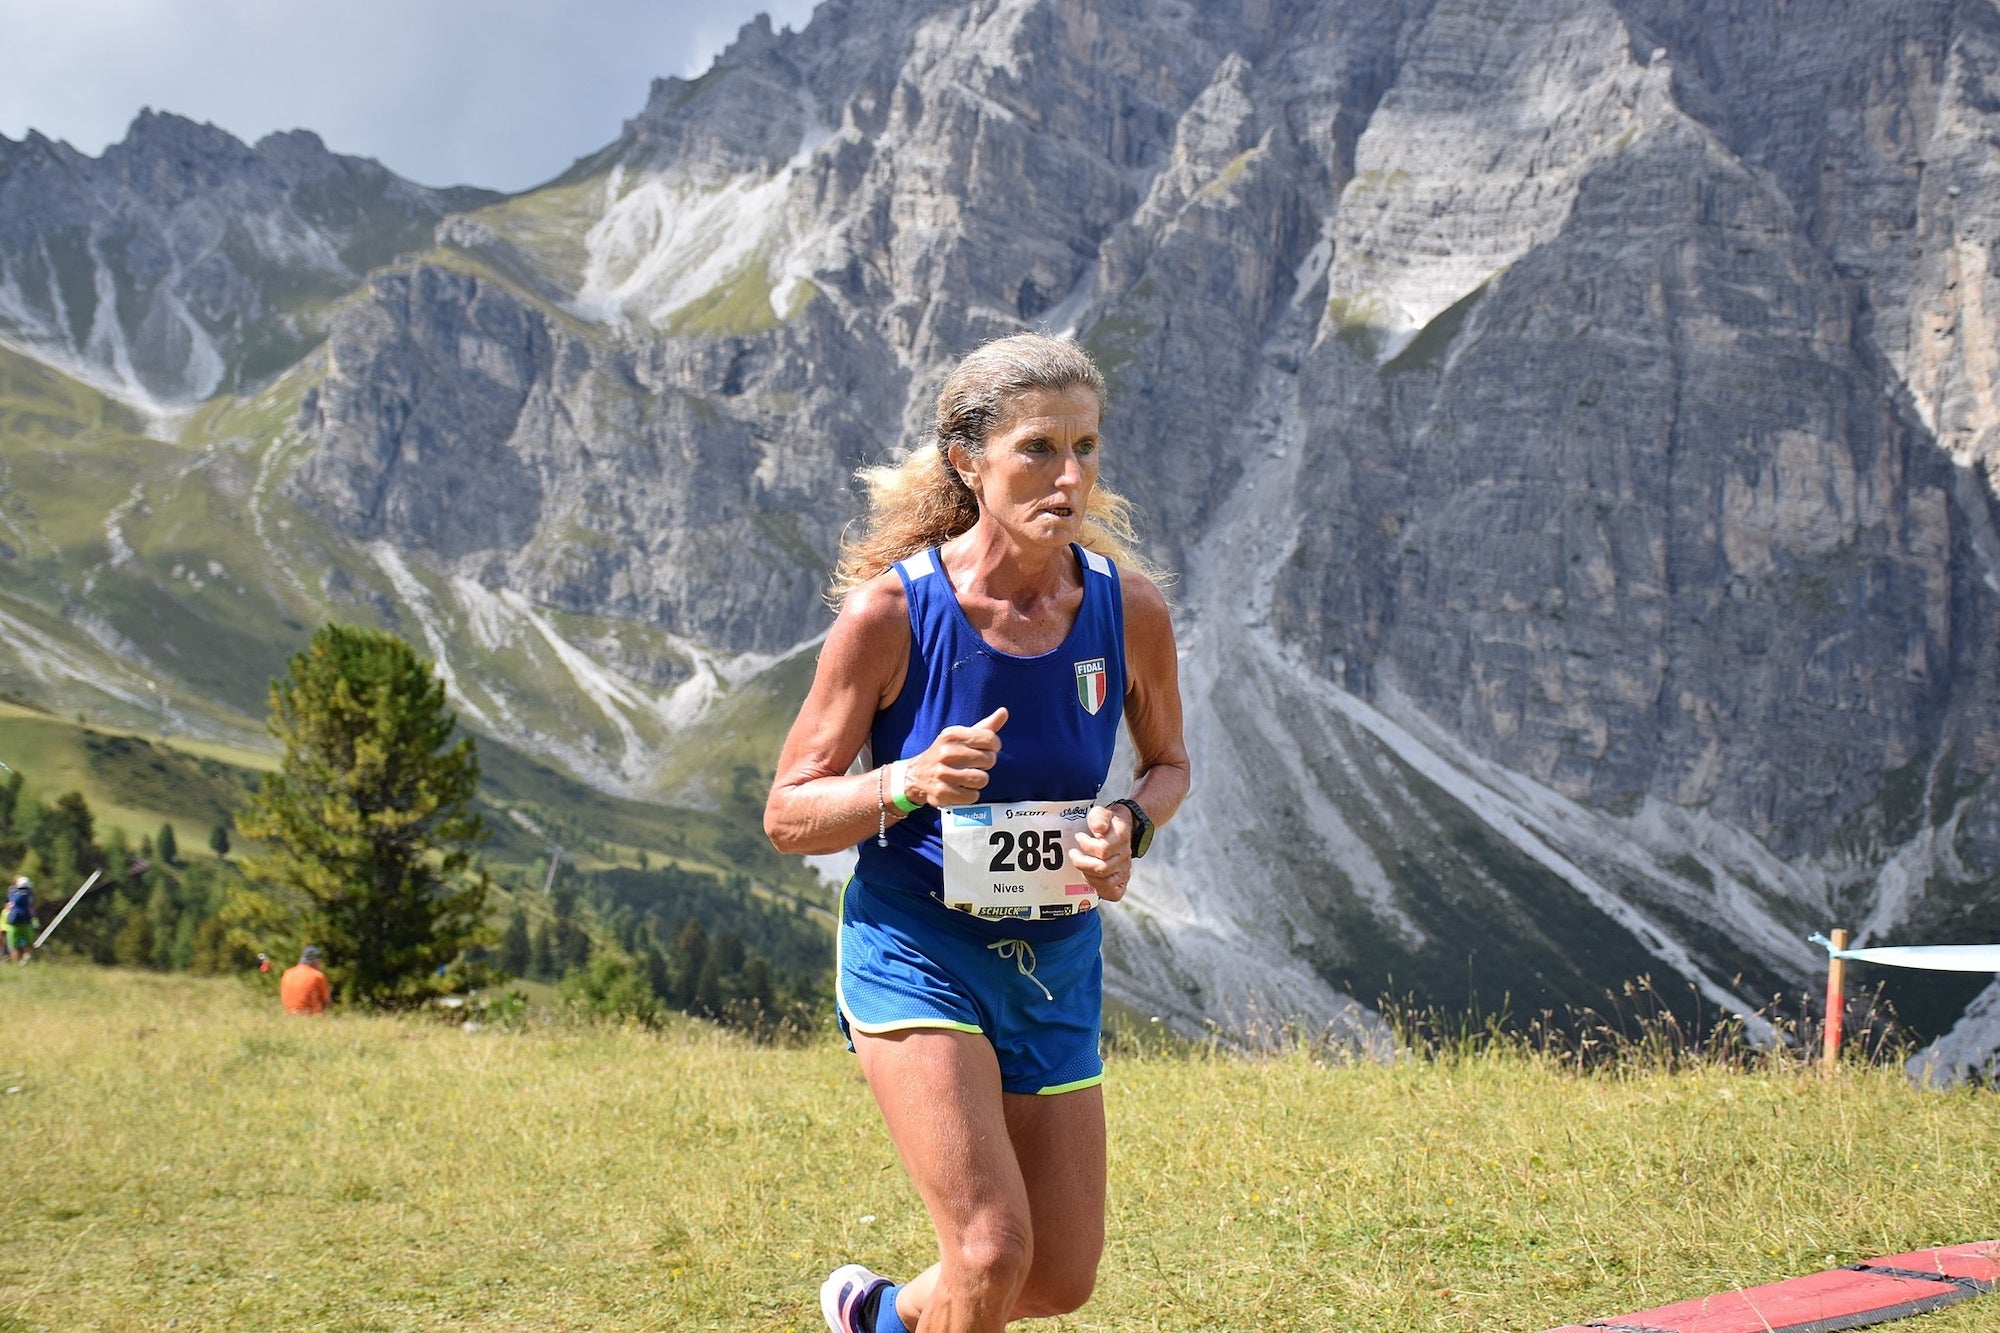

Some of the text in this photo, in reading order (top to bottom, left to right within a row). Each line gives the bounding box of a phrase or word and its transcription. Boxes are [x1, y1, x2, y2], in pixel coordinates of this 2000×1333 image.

[1077, 661, 1103, 675] FIDAL
[989, 829, 1064, 872] 285
[993, 883, 1025, 894] Nives
[980, 906, 1019, 916] SCHLICK
